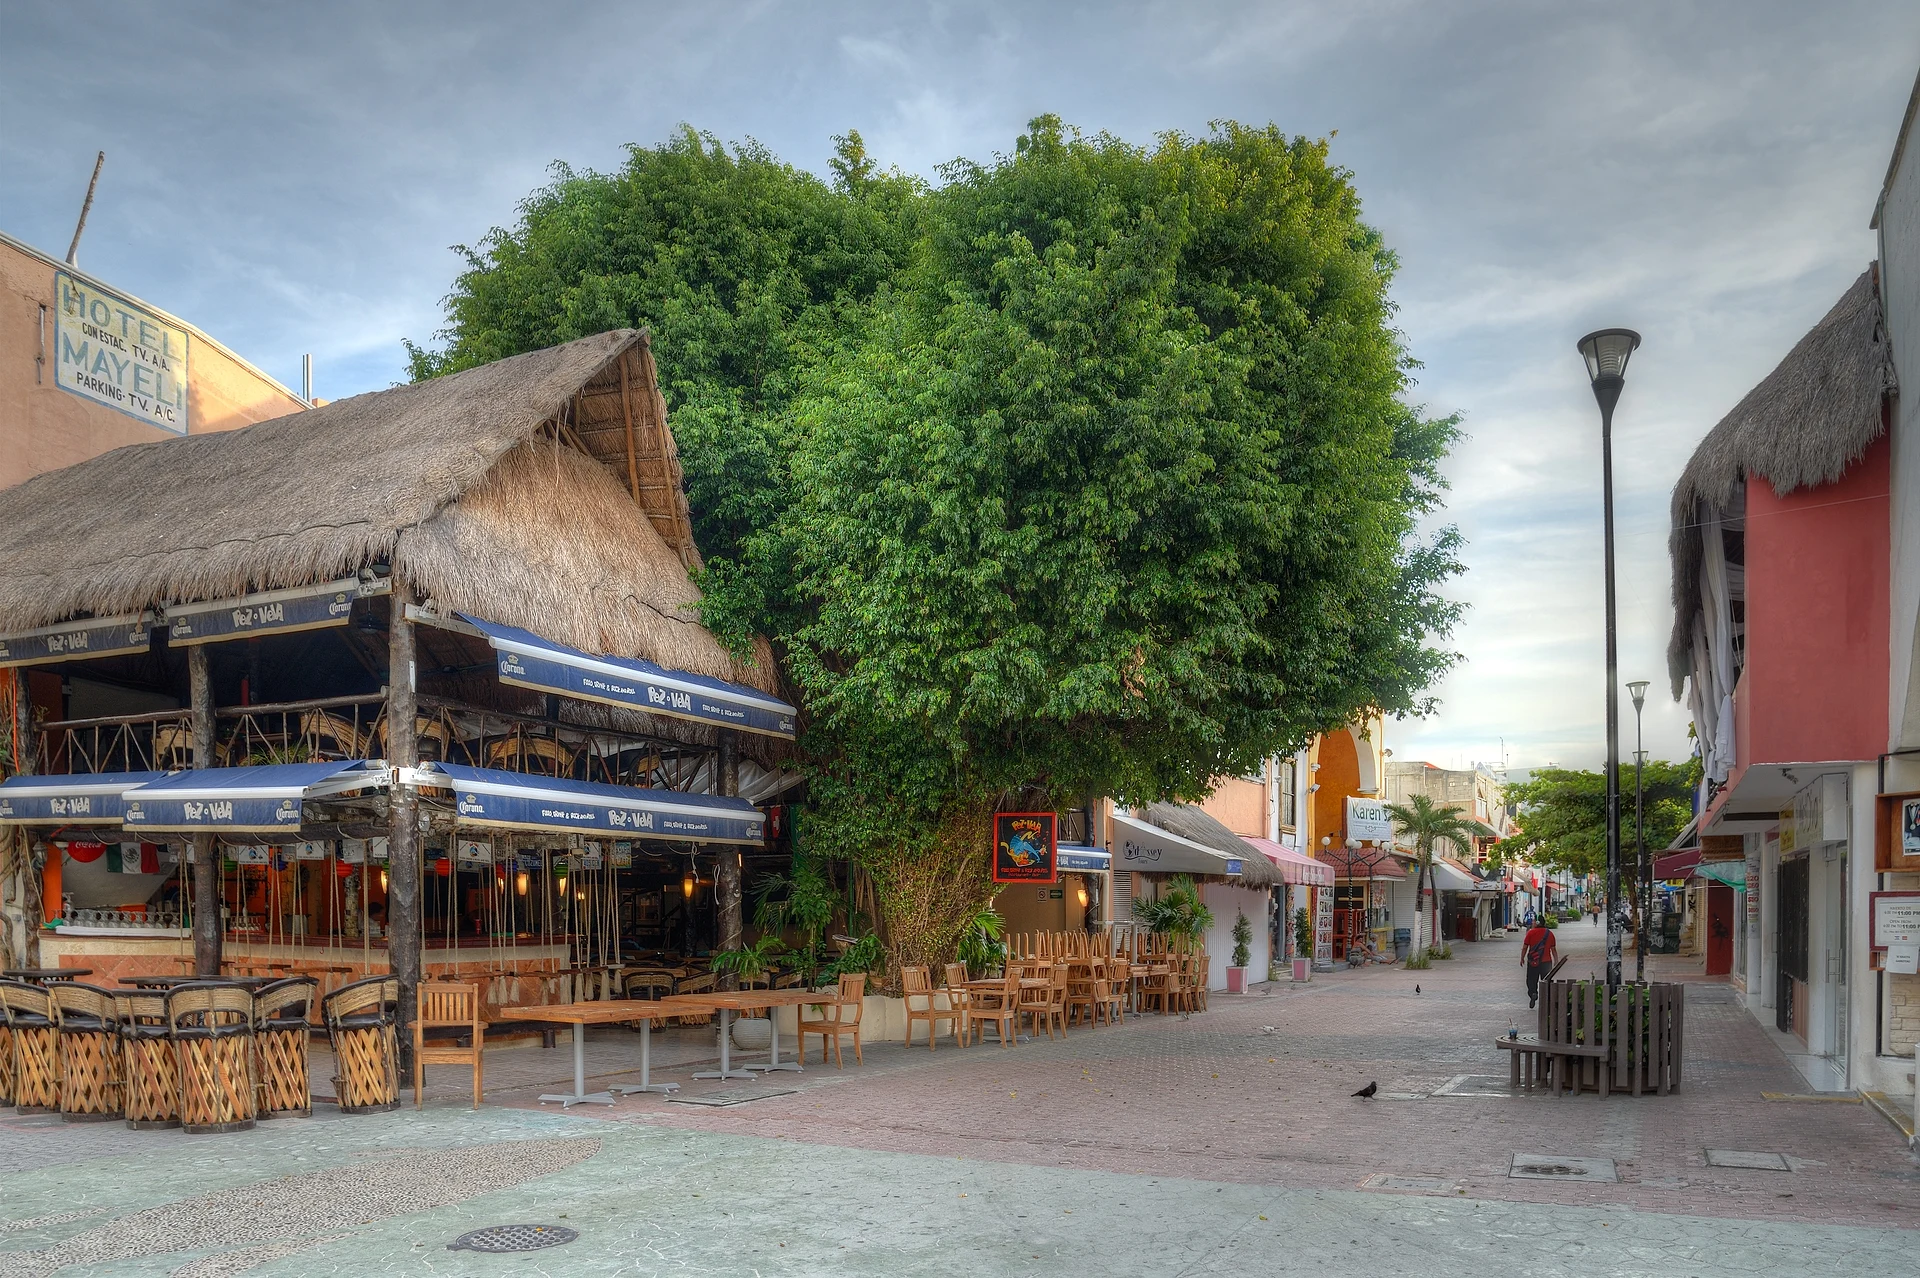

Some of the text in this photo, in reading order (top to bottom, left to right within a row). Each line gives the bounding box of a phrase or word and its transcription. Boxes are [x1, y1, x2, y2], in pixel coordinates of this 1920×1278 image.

[64, 284, 182, 363] HOTEL
[82, 322, 170, 372] CON ESTAC. TV. A/A.
[63, 332, 182, 410] MAYELI
[128, 393, 148, 412] TV.
[154, 404, 175, 422] A/C.
[501, 660, 526, 675] Corona
[276, 808, 299, 822] Corona
[459, 802, 484, 814] Corona
